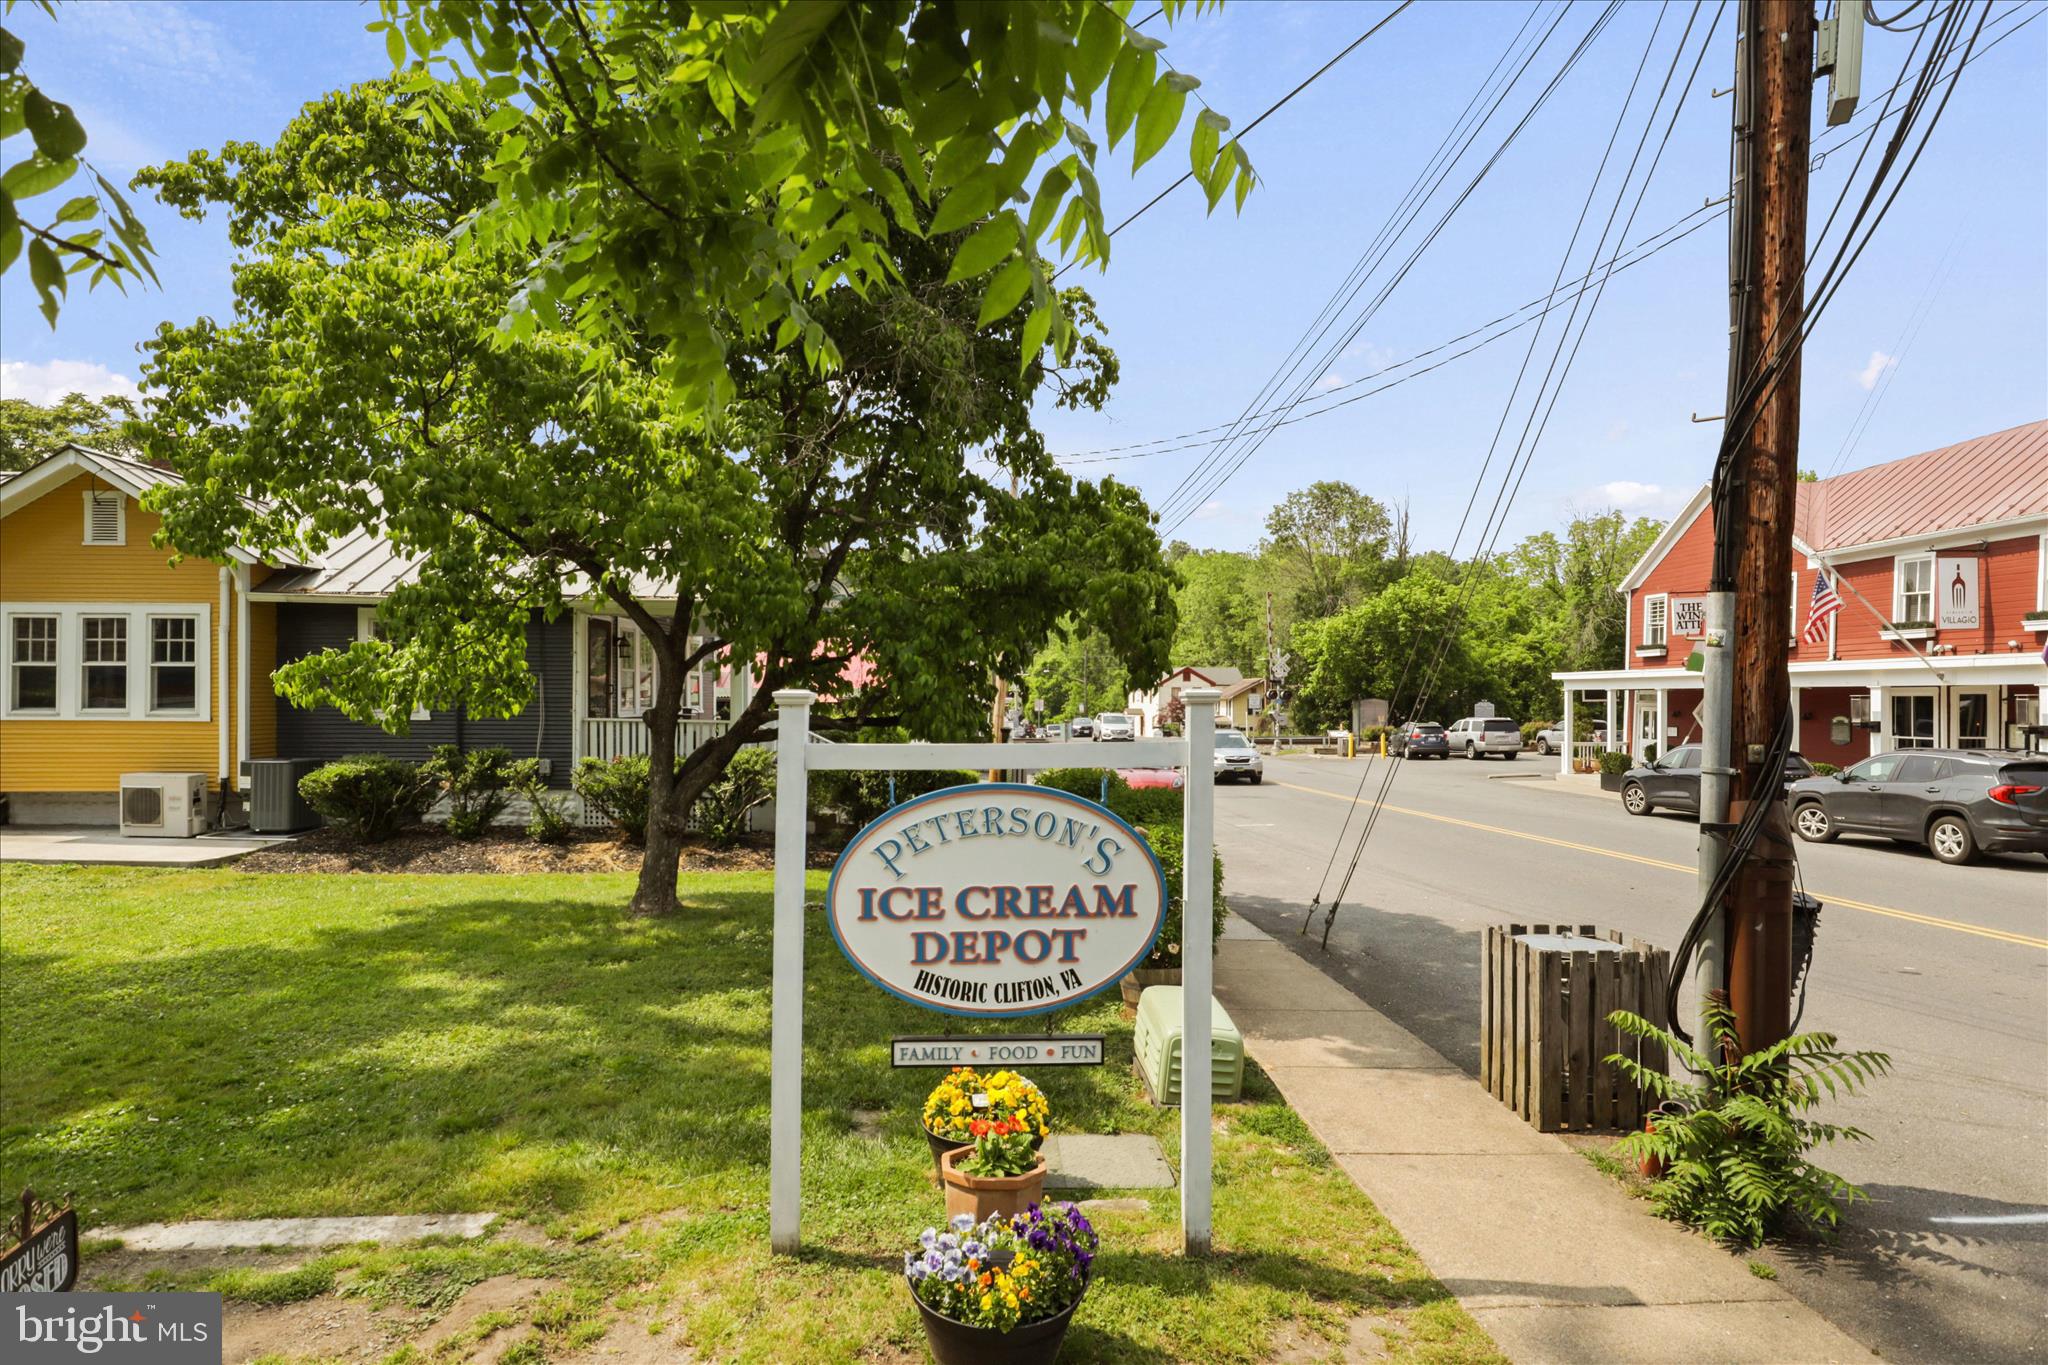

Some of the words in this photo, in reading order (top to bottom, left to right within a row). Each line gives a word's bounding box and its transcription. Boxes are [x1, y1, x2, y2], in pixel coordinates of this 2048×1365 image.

[1676, 611, 1702, 620] WIN
[1676, 620, 1702, 630] ATTI
[1942, 615, 1977, 624] VILLAGIO
[870, 806, 1125, 880] PETERSON'S
[857, 886, 946, 922] ICE
[954, 884, 1138, 920] CREAM
[910, 928, 1087, 966] DEPOT
[913, 969, 988, 1004] HISTORIC
[994, 975, 1060, 1004] CLIFTON,
[1059, 968, 1083, 991] VA
[900, 1047, 964, 1061] FAMILY
[989, 1046, 1038, 1060] FOOD
[1061, 1045, 1097, 1059] FUN
[0, 1246, 36, 1292] ORRY
